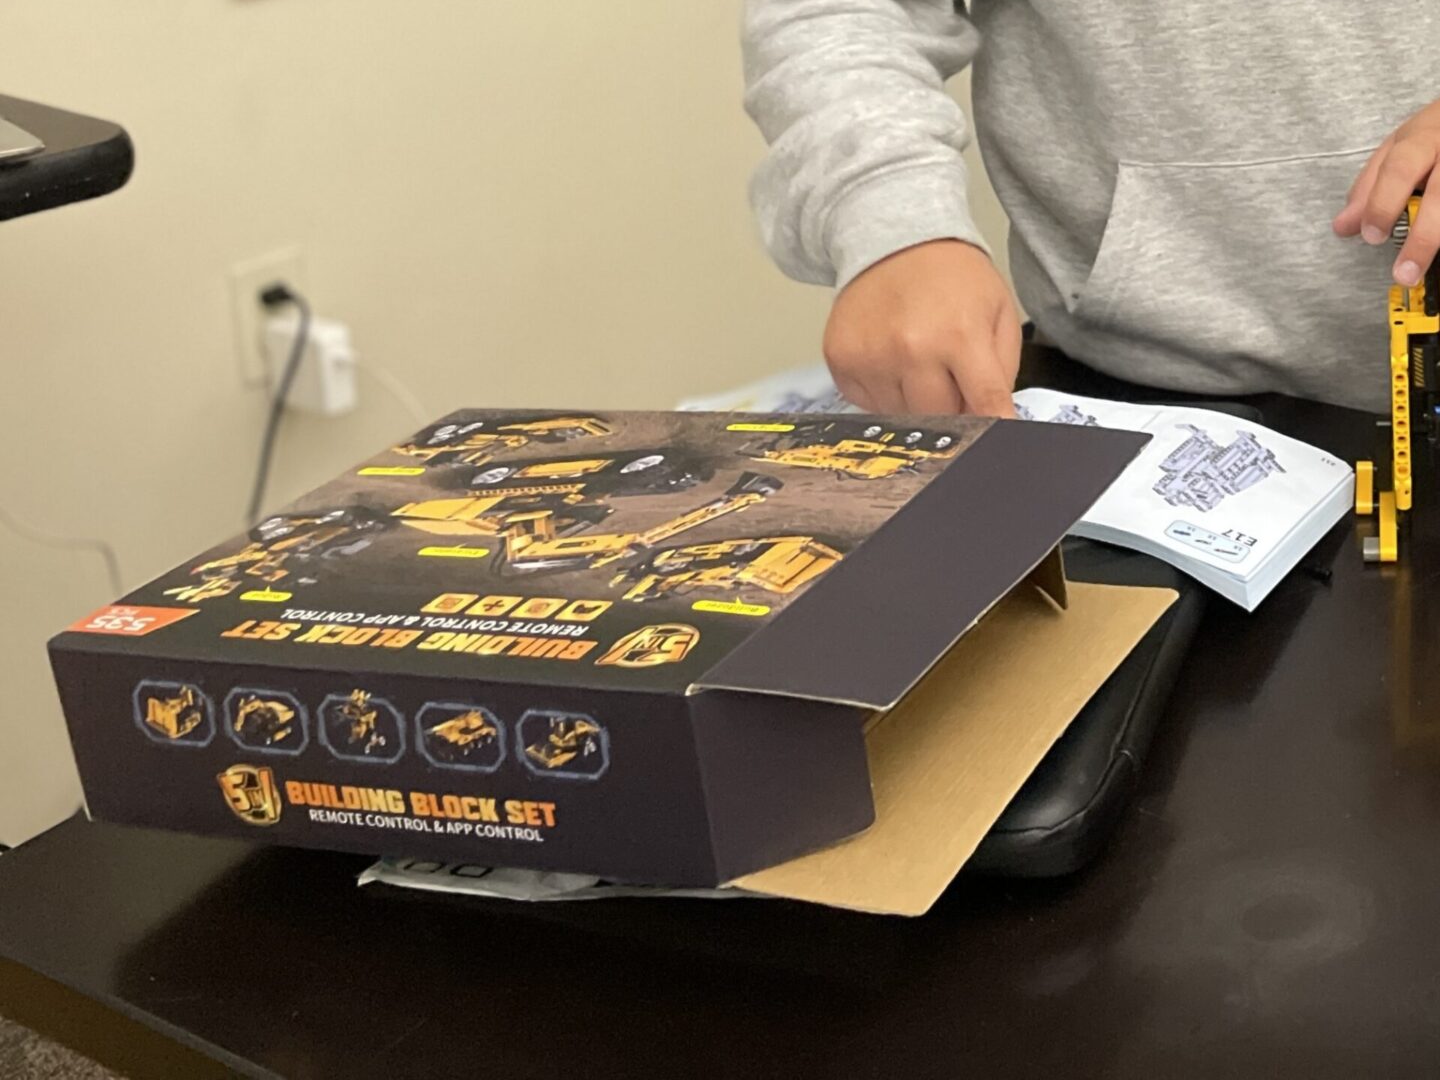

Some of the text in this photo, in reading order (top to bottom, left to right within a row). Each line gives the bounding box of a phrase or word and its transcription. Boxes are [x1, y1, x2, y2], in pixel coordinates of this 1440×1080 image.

[1221, 528, 1258, 547] E17
[85, 615, 156, 632] 535
[280, 608, 589, 636] REMOTE CONTROL & APP CONTROL
[221, 619, 598, 660] BUILDING BLOCK SET
[285, 780, 556, 827] BUILDING BLOCK SET
[309, 809, 544, 842] REMOTE CONTROL & APP CONTROL
